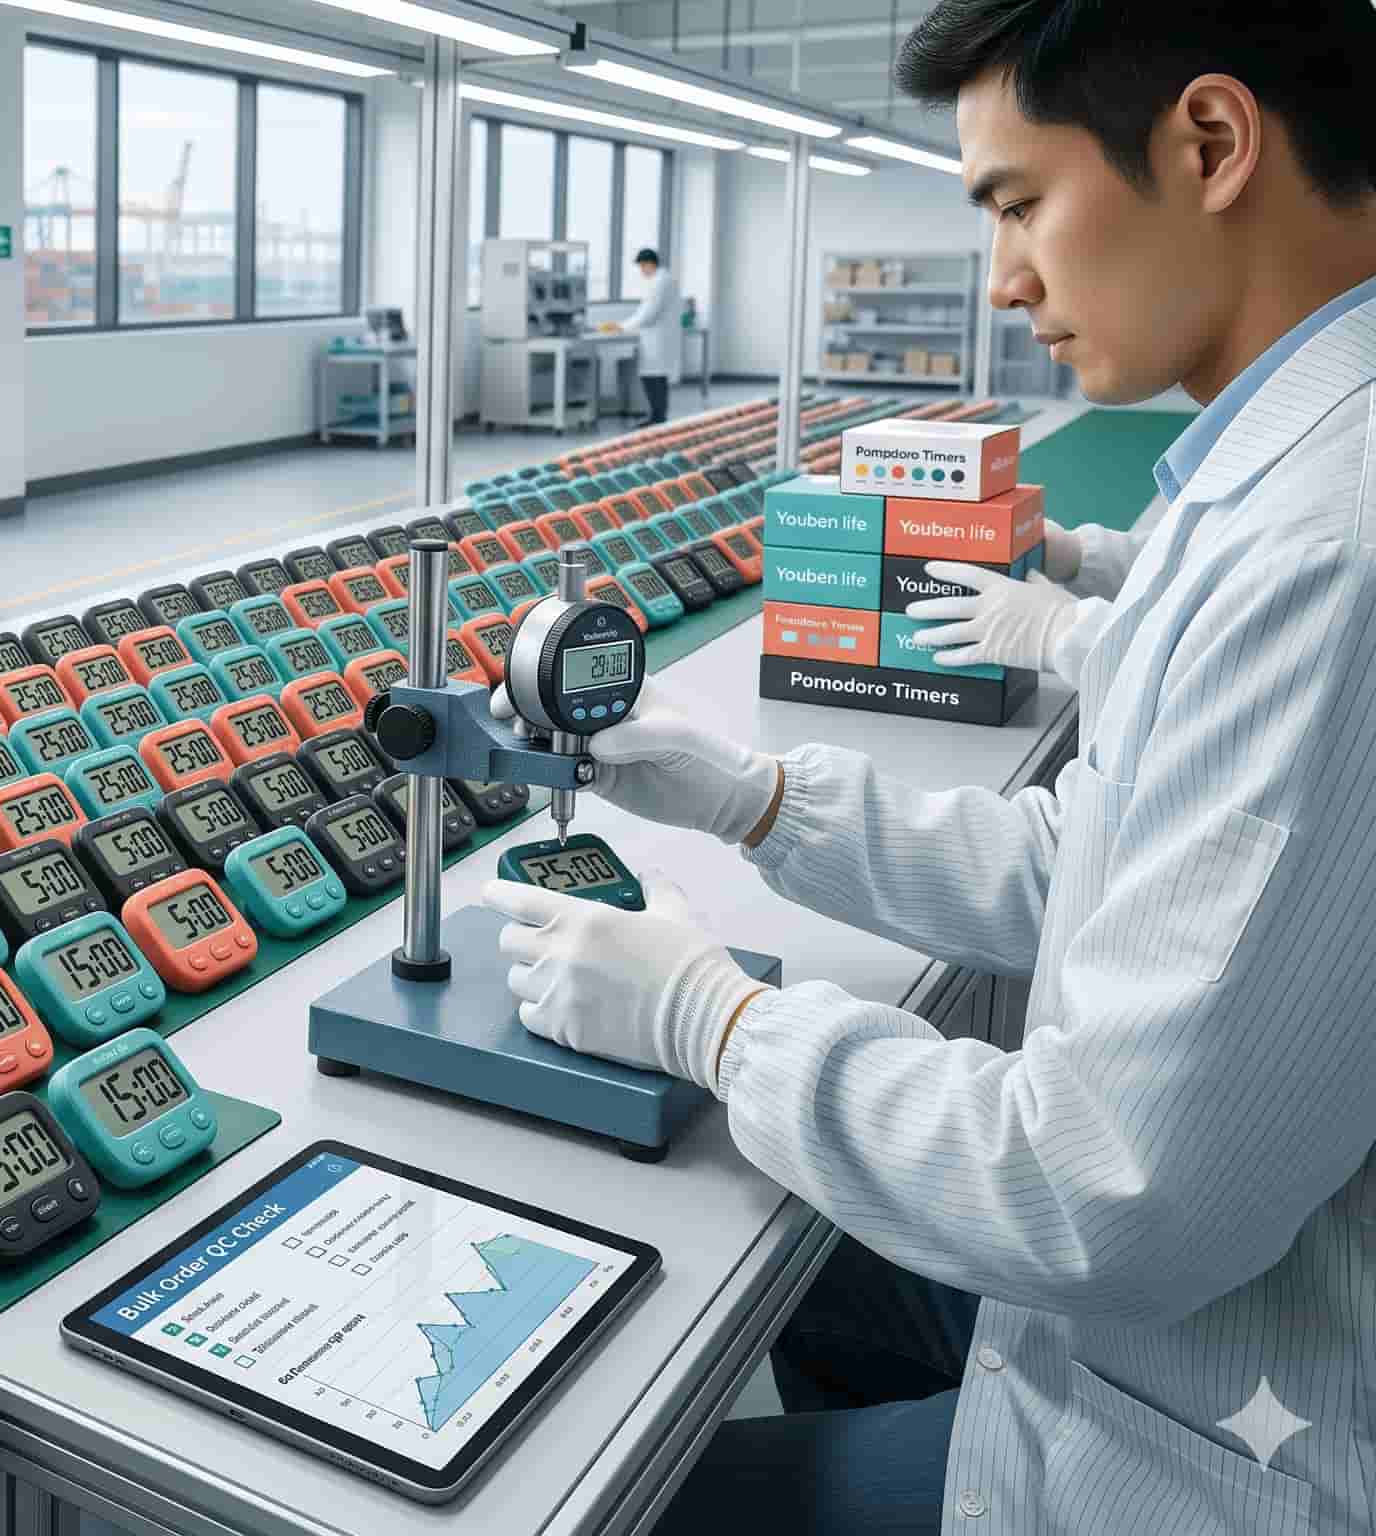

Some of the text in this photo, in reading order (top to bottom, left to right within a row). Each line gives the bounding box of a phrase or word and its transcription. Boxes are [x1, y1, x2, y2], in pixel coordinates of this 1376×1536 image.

[922, 450, 966, 464] Timers
[775, 511, 867, 531] Youben life
[899, 520, 965, 539] Youben
[970, 524, 996, 541] life
[775, 567, 867, 588] Youben life
[896, 576, 962, 595] Youben
[11, 680, 64, 711] 25:00
[304, 685, 357, 721] 25:00
[790, 671, 960, 705] Pomodoro Timers
[102, 702, 162, 735] 25:00
[235, 716, 289, 749] 25:00
[32, 725, 93, 762] 25:00
[169, 738, 223, 771] 25:00
[328, 744, 374, 776] 5:00
[90, 762, 152, 803] 25:00
[264, 771, 312, 809] 5:00
[7, 792, 74, 836] 25:00
[194, 795, 244, 833] 5:00
[113, 826, 173, 866] 5:00
[342, 814, 391, 852] 5:00
[21, 857, 83, 904] 5:00
[271, 848, 319, 889] 5:00
[528, 853, 615, 889] 25:00
[168, 894, 229, 938] 5:00
[59, 938, 133, 990] 15:00
[99, 1058, 183, 1123] 15:00
[117, 1284, 164, 1322] Bulk
[159, 1255, 209, 1291] Order
[206, 1236, 237, 1257] QC
[232, 1202, 286, 1238] Check
